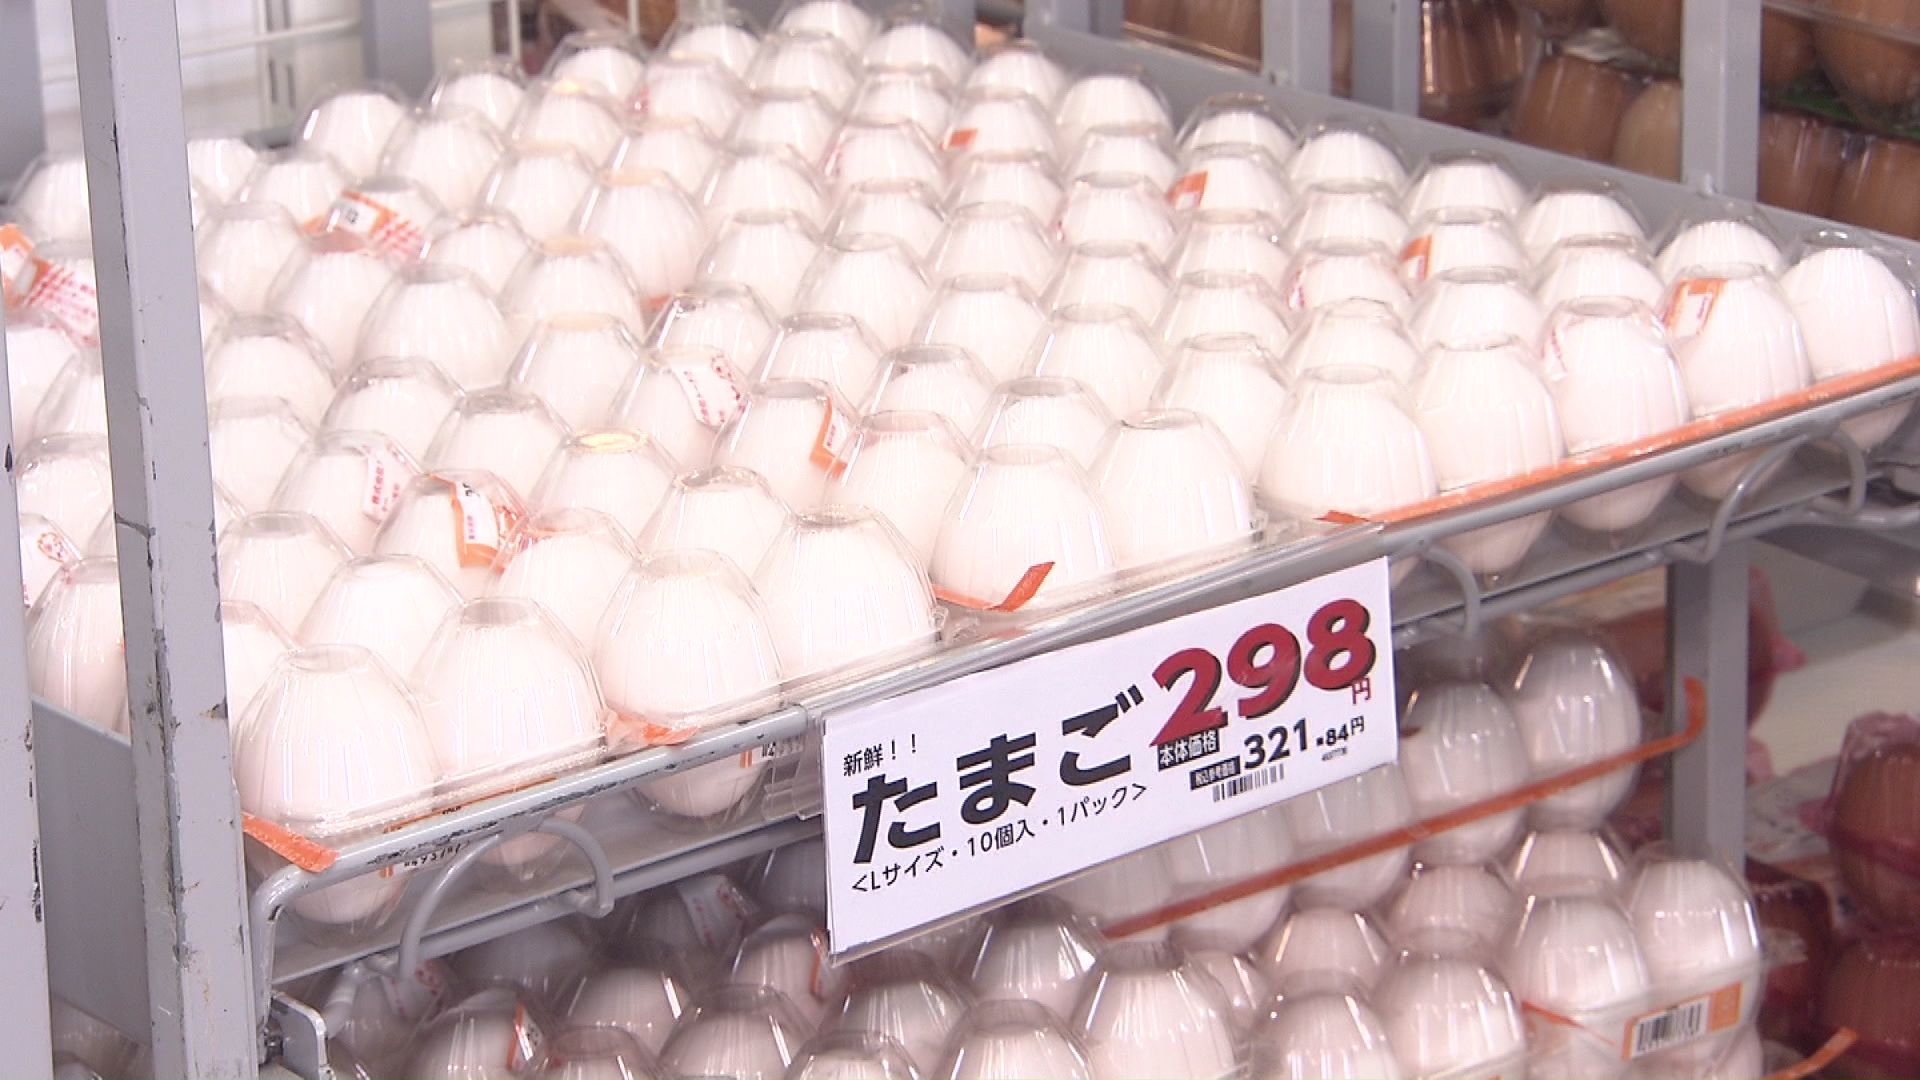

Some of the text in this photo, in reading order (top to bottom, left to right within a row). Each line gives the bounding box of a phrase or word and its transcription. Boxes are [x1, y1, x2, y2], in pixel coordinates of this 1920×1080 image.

[852, 684, 1145, 864] たまご
[1159, 731, 1218, 768] 本体価格
